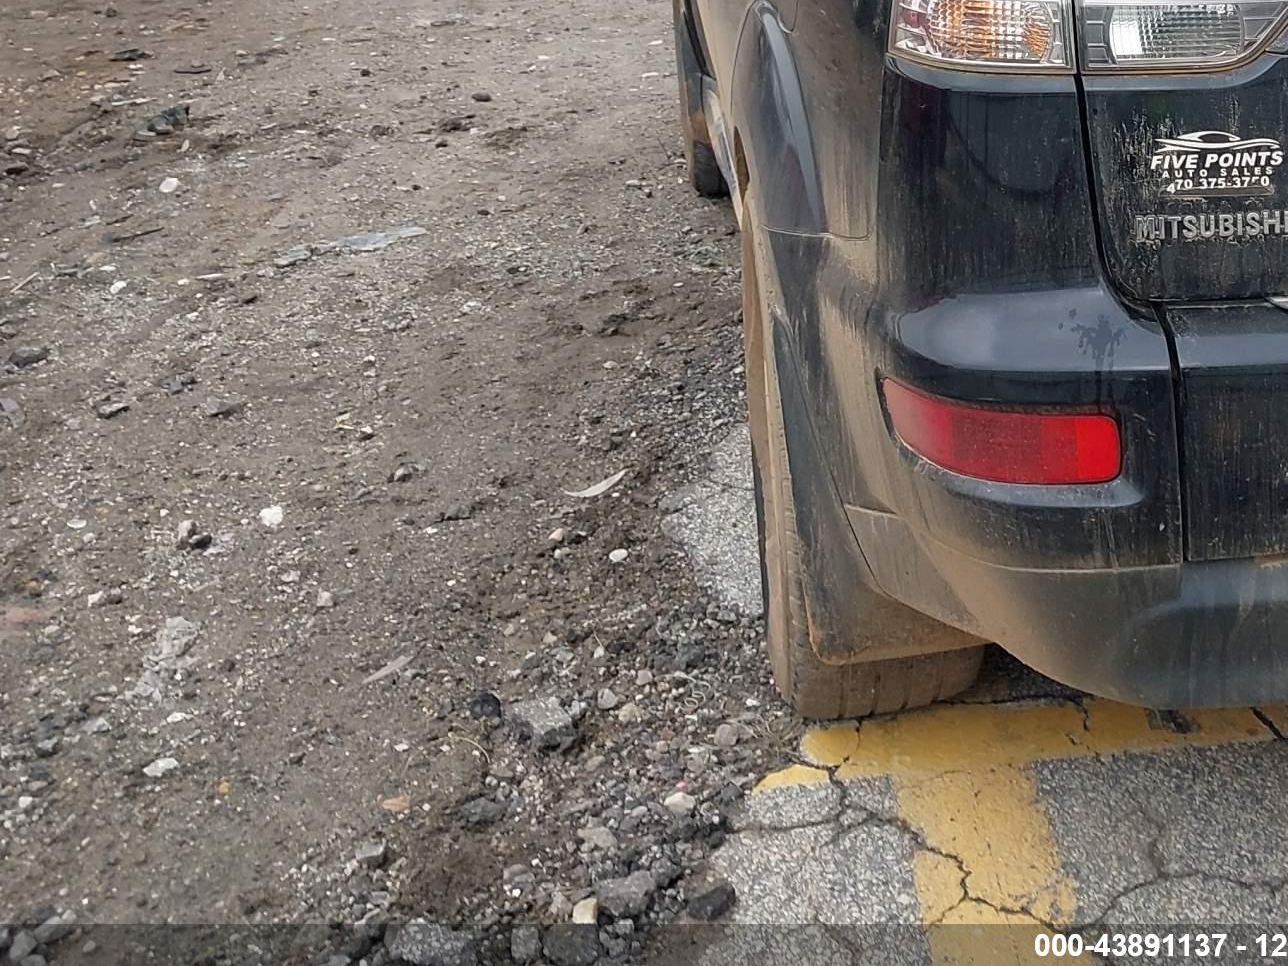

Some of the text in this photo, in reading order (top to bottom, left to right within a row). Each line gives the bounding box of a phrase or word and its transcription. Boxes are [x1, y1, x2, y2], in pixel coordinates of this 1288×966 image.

[1150, 151, 1284, 169] FIVE POINTS
[1162, 166, 1273, 179] AUTO SALES
[1167, 178, 1193, 194] 470
